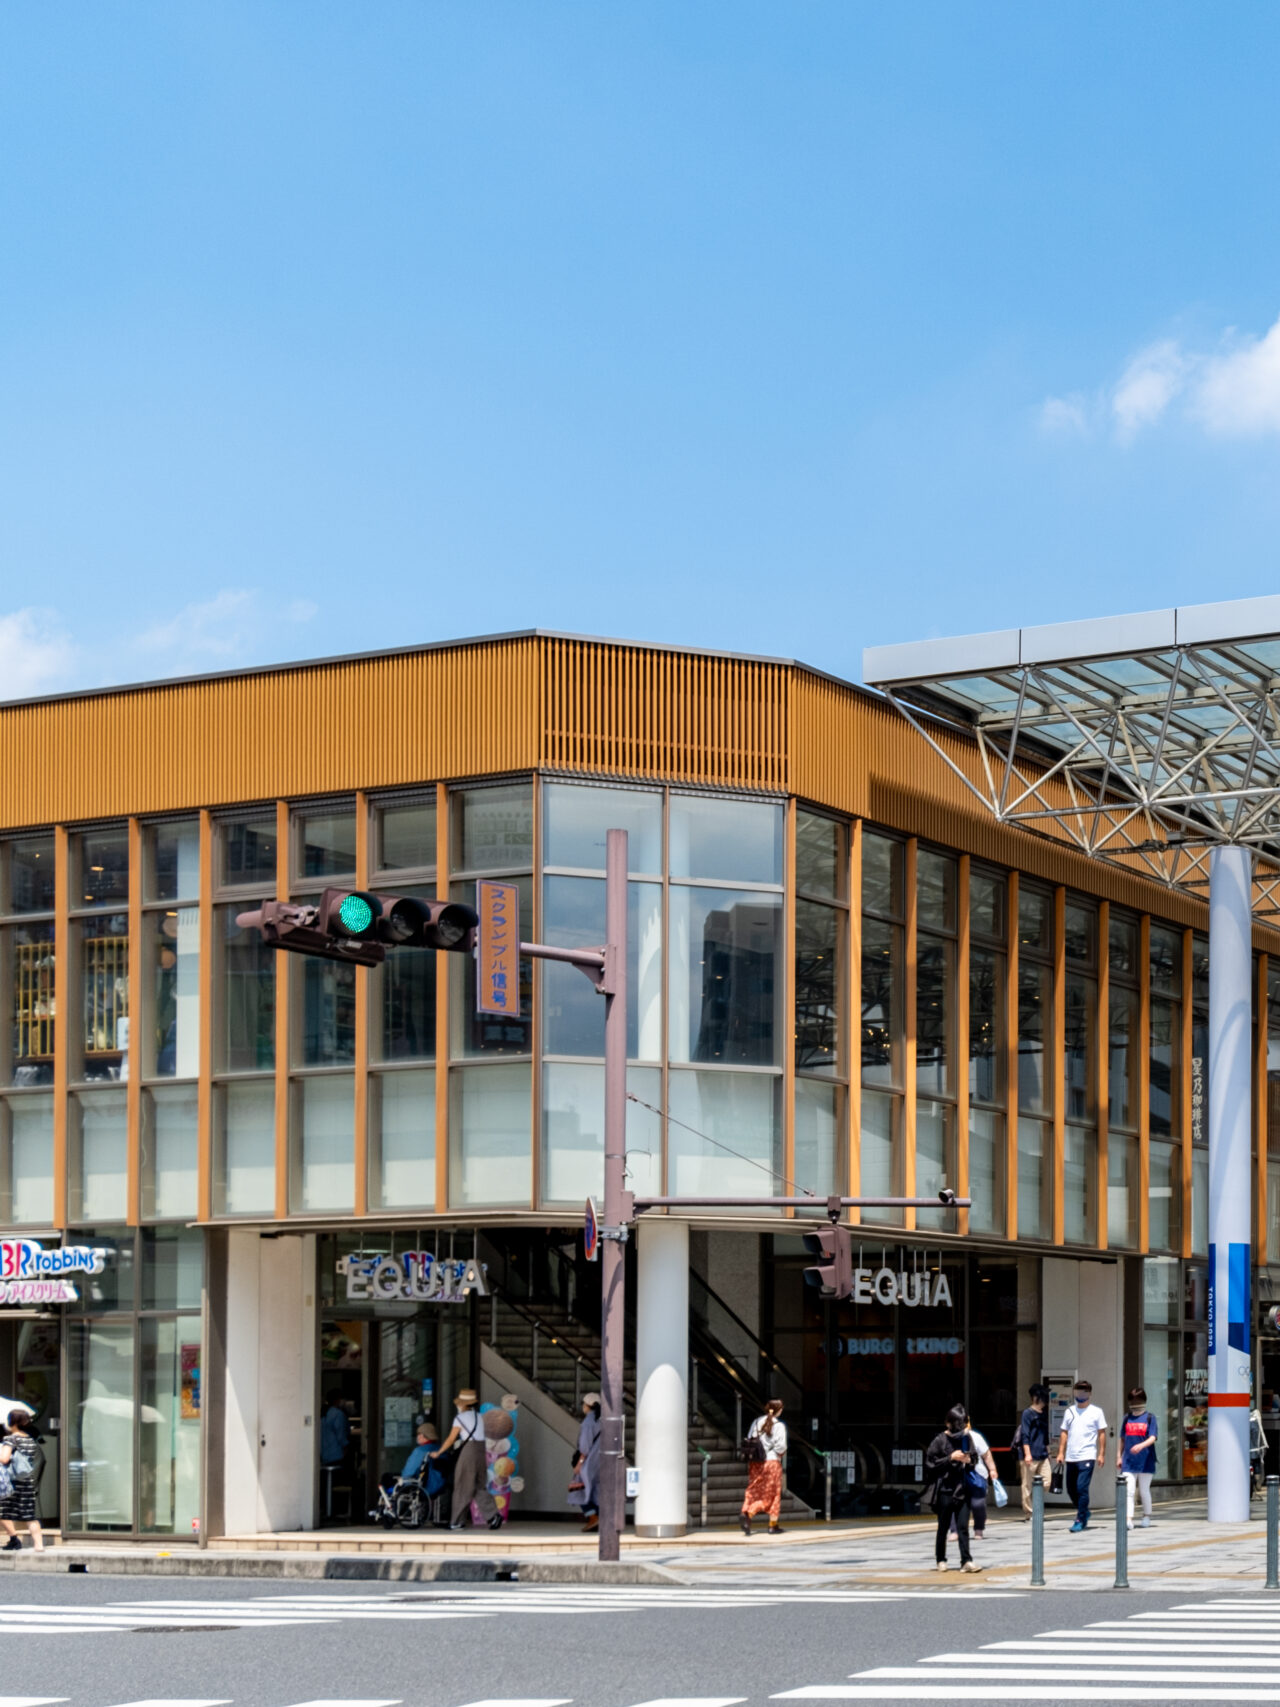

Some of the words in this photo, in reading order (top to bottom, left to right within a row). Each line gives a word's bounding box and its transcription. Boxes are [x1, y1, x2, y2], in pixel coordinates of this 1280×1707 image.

[491, 888, 507, 1007] スクランブル信号
[36, 1248, 95, 1271] robbins
[917, 1337, 960, 1355] KING
